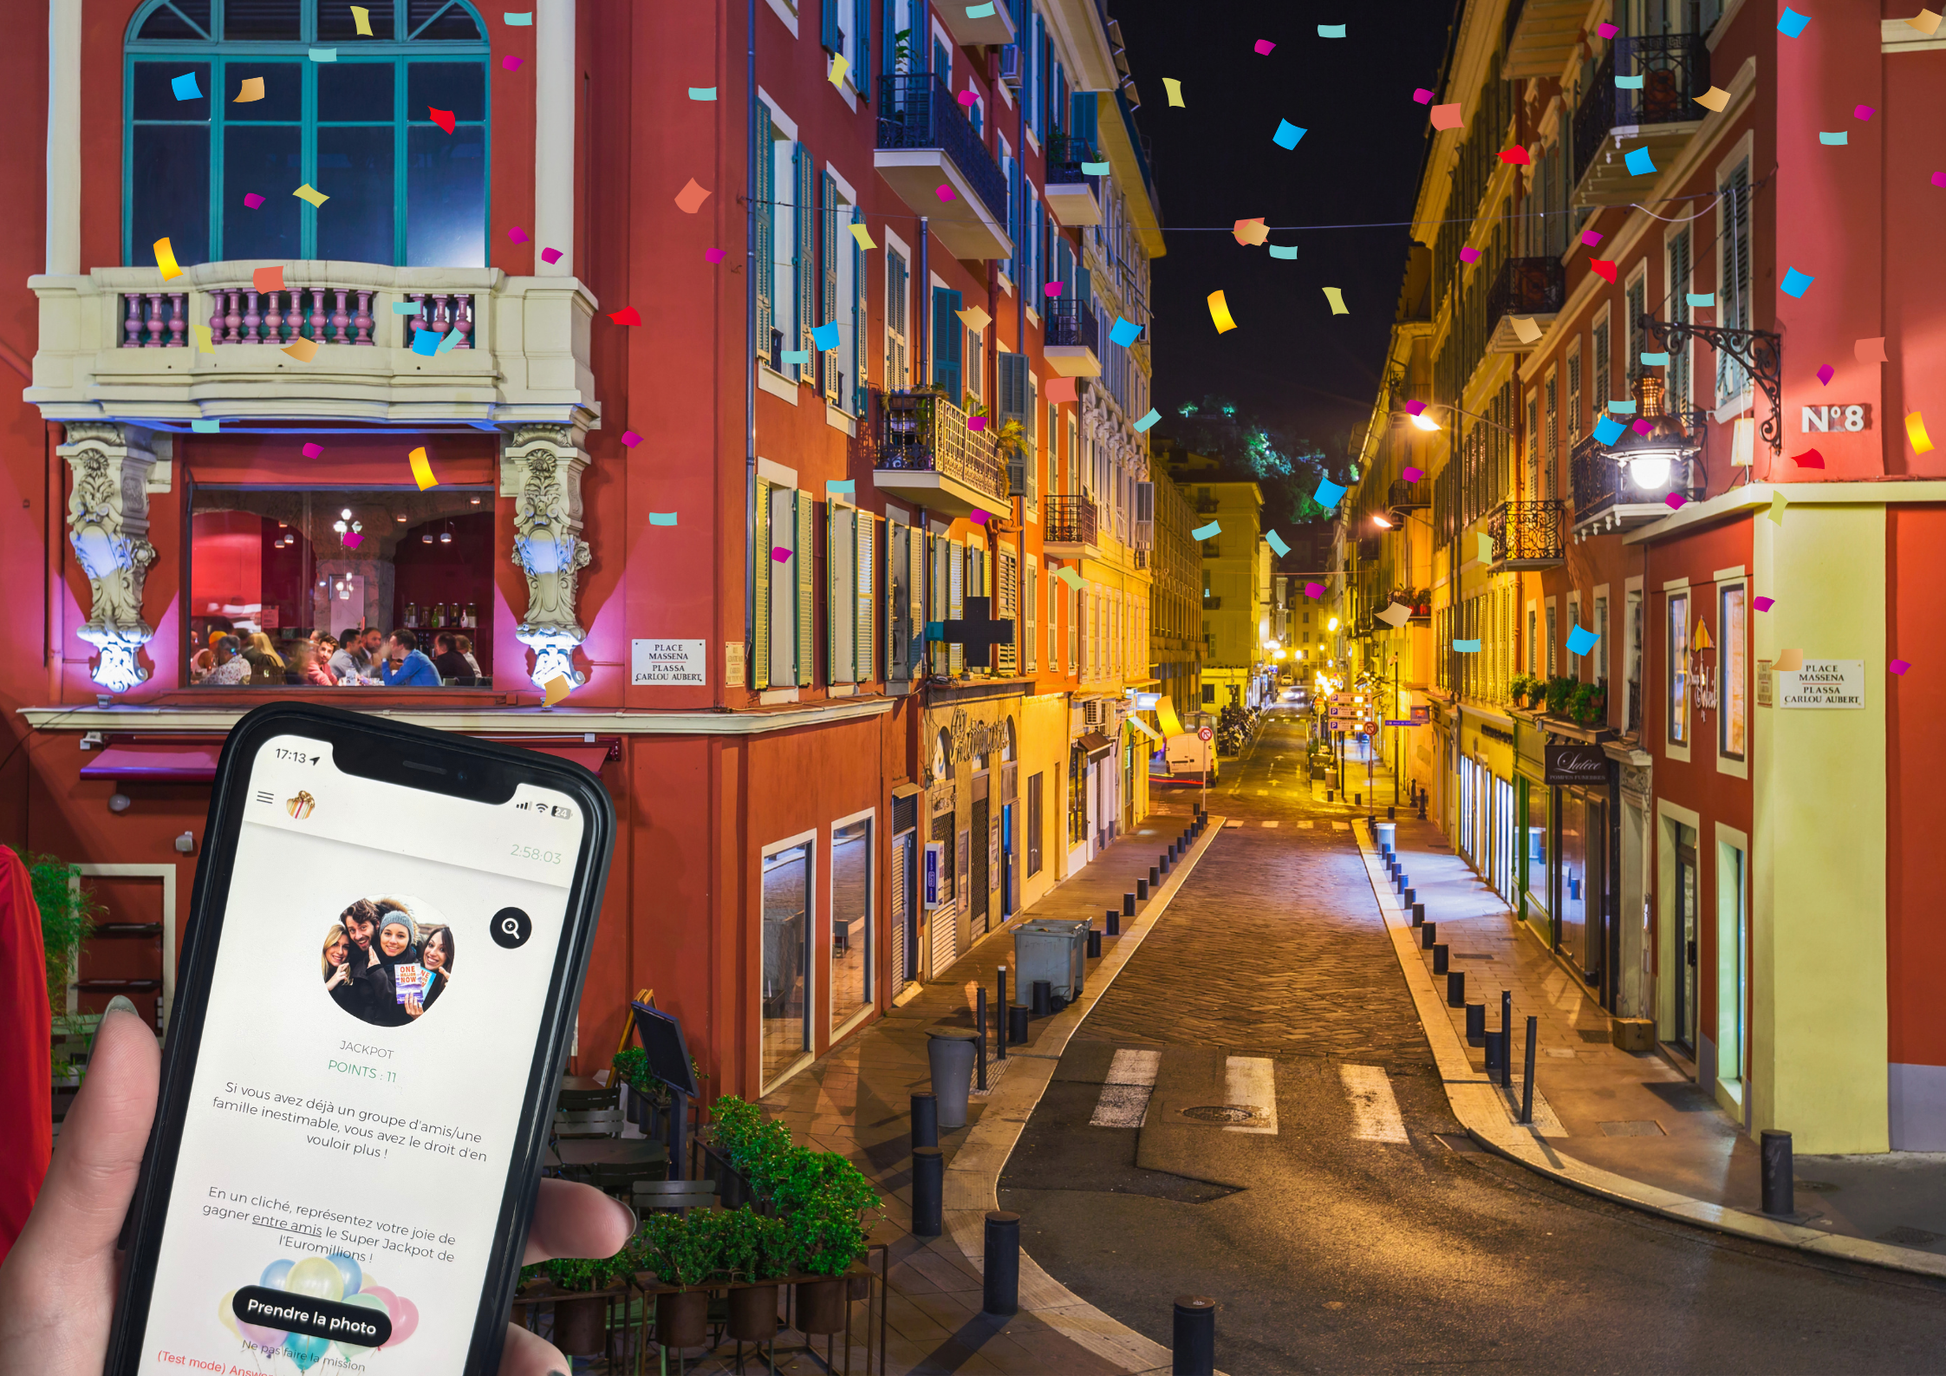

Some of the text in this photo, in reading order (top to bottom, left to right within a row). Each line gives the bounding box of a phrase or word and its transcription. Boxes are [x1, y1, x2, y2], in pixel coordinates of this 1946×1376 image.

[654, 644, 683, 652] PLACE
[636, 673, 701, 681] CARLOU AUBERT
[652, 664, 685, 672] PLASSA
[1799, 673, 1844, 681] MASSENA
[1805, 664, 1838, 672] PLACE
[1784, 695, 1859, 704] CARLOU AUBERT
[1803, 686, 1841, 694] PLASSA
[275, 748, 307, 764] 17:13
[554, 807, 568, 818] 24
[510, 843, 562, 865] 2:58:03
[399, 965, 416, 973] ONE
[339, 1040, 395, 1060] JACKPOT
[327, 1059, 378, 1079] POINTS
[386, 1070, 397, 1083] 11
[225, 1081, 482, 1144] Si vous avez déjà un groupe d'amis/une
[212, 1096, 488, 1162] famille inestimable, vous avez le droit d'en
[306, 1134, 351, 1152] vouloir
[353, 1143, 382, 1158] plus
[208, 1186, 456, 1246] En un cliché, représentez votre joie de
[202, 1204, 455, 1263] gagner entre amis le Super Jackpot de
[278, 1234, 366, 1262] l'Euromillions
[247, 1298, 377, 1336] Prendre la photo
[157, 1349, 186, 1366] (Test
[188, 1357, 226, 1375] mode)
[241, 1339, 366, 1372] Ne pas faire la mission
